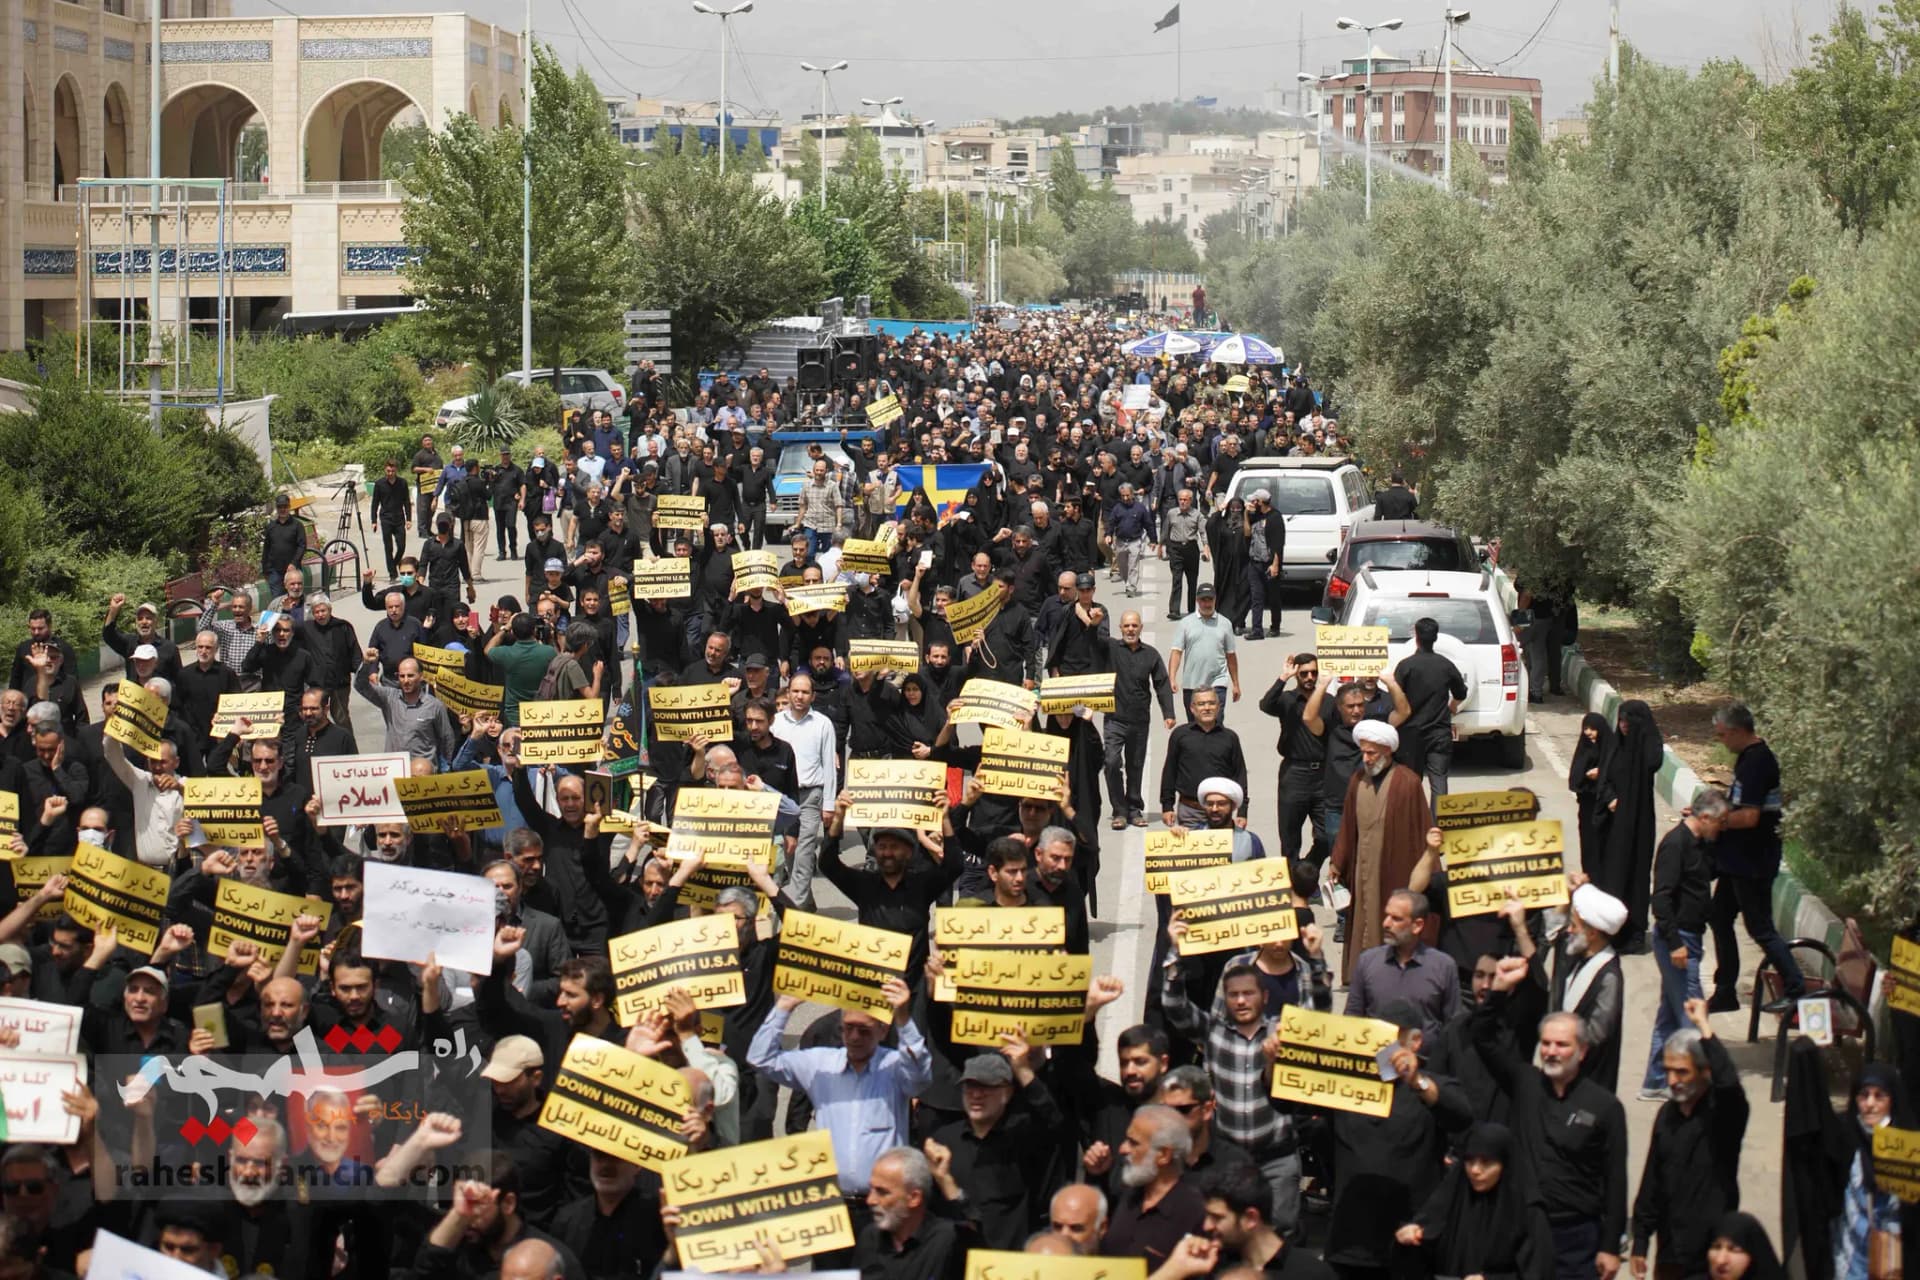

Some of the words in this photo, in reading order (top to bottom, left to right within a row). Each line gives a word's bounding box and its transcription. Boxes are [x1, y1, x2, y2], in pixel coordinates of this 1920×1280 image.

[688, 696, 698, 706] بر
[702, 690, 727, 704] مرگ
[559, 712, 569, 723] بر
[574, 706, 600, 721] مرگ
[654, 712, 679, 720] DOWN
[680, 712, 703, 720] WITH
[706, 710, 730, 718] U.S.A
[522, 729, 549, 738] DOWN
[550, 728, 575, 737] WITH
[577, 727, 602, 736] U.S.A
[568, 743, 601, 759] الموت
[1007, 759, 1031, 769] WITH
[1032, 763, 1064, 774] ISRAEL
[460, 776, 487, 790] مرگ
[913, 768, 942, 785] مرگ
[235, 784, 259, 801] مرگ
[338, 785, 389, 814] اسلام
[884, 790, 912, 799] WITH
[185, 809, 210, 818] DOWN
[212, 809, 235, 818] WITH
[236, 809, 260, 819] U.S.A
[464, 812, 501, 826] الموت
[902, 810, 938, 825] الموت
[1438, 819, 1471, 827] DOWN
[1474, 814, 1500, 823] WITH
[1502, 812, 1530, 821] U.S.A
[673, 821, 705, 832] DOWN
[708, 823, 734, 832] WITH
[735, 823, 771, 832] ISRAEL
[229, 828, 260, 843] الموت
[1523, 829, 1558, 850] مرگ
[1145, 860, 1173, 868] DOWN
[1174, 859, 1198, 867] WITH
[1198, 857, 1229, 866] ISRAEL
[1448, 867, 1488, 880] DOWN
[1490, 862, 1526, 874] WITH
[1527, 858, 1562, 871] U.S.A
[1250, 867, 1284, 887] مرگ
[125, 879, 140, 892] بر
[142, 877, 166, 898] مرگ
[1230, 879, 1242, 892] بر
[70, 875, 100, 897] DOWN
[100, 891, 127, 909] WITH
[129, 902, 160, 920] ISRAEL
[1218, 899, 1253, 914] WITH
[1255, 894, 1290, 908] U.S.A
[270, 908, 285, 922] بر
[117, 923, 155, 944] الموت
[215, 912, 252, 932] DOWN
[255, 924, 287, 939] WITH
[998, 925, 1013, 941] بر
[1022, 917, 1058, 939] مرگ
[1247, 916, 1291, 936] الموت
[697, 926, 731, 946] مرگ
[786, 922, 841, 947] اسرائیل
[672, 938, 684, 953] بر
[844, 941, 860, 956] بر
[867, 939, 902, 962] مرگ
[780, 950, 817, 965] DOWN
[820, 959, 852, 974] WITH
[616, 969, 658, 990] DOWN
[660, 961, 696, 976] WITH
[700, 954, 738, 969] U.S.A
[961, 962, 1021, 984] اسرائیل
[1027, 972, 1042, 986] بر
[1049, 963, 1086, 986] مرگ
[692, 979, 738, 1002] الموت
[957, 993, 998, 1006] DOWN
[1001, 996, 1035, 1008] WITH
[1038, 997, 1082, 1008] ISRAEL
[1032, 1016, 1081, 1039] الموت
[1332, 1034, 1346, 1048] بر
[1320, 1058, 1353, 1070] WITH
[634, 1080, 654, 1094] بر
[556, 1073, 599, 1100] DOWN
[602, 1095, 639, 1118] WITH
[1342, 1085, 1388, 1106] الموت
[779, 1147, 828, 1174] مرگ
[751, 1164, 769, 1186] بر
[736, 1195, 786, 1215] WITH
[789, 1184, 841, 1205] U.S.A
[776, 1215, 843, 1244] الموت
